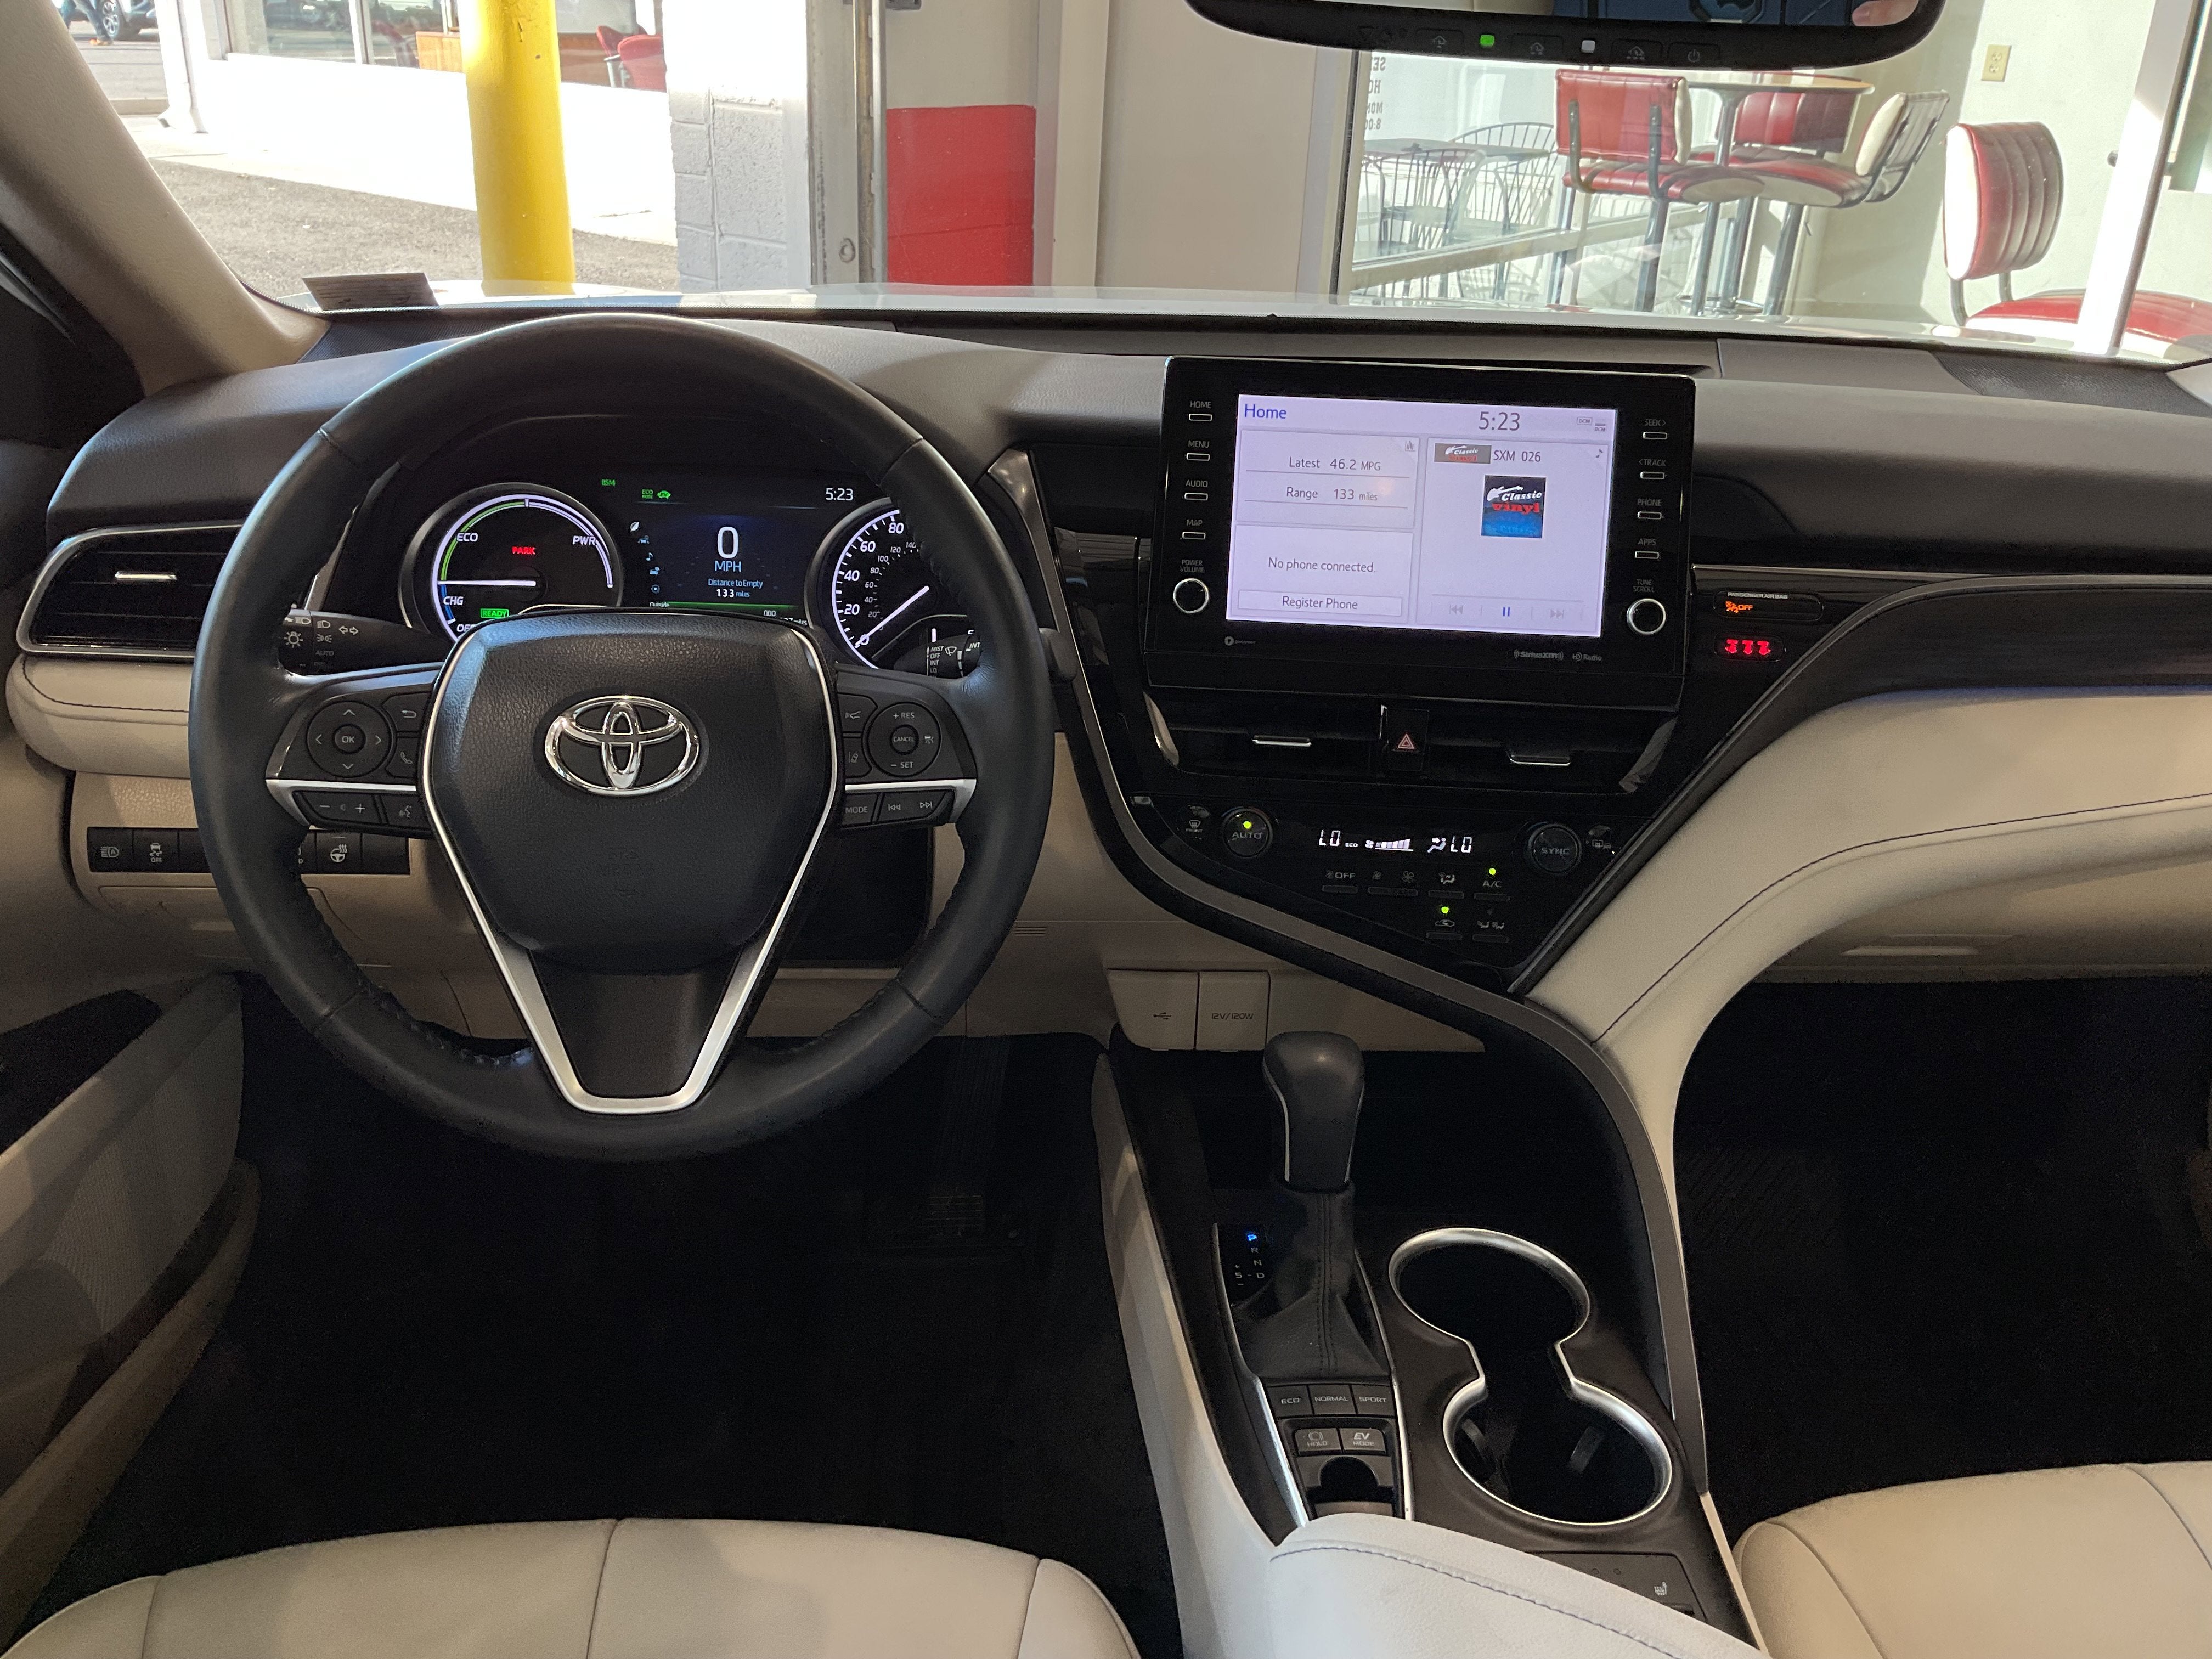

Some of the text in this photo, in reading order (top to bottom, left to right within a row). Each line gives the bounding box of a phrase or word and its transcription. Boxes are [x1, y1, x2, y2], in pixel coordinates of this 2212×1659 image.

[1244, 404, 1287, 419] Home
[1479, 411, 1520, 431] 5:23
[1493, 450, 1541, 462] SXM 026
[1289, 456, 1381, 471] Latest 46.2 MPG
[825, 488, 854, 502] 5:23
[1286, 487, 1378, 501] Range 133 miles
[1502, 490, 1542, 501] Classic
[1492, 501, 1540, 515] vinyl
[1637, 498, 1662, 506] PHONE
[888, 522, 904, 534] 80
[456, 532, 478, 542] ECO
[572, 535, 596, 545] PWR
[717, 526, 738, 558] 0
[860, 541, 876, 552] 60
[714, 560, 741, 572] MPH
[1268, 557, 1376, 572] No phone connected.
[844, 570, 860, 582] 40
[708, 578, 735, 586] Distance
[743, 579, 763, 589] Empty
[716, 589, 734, 597] 133
[443, 596, 464, 606] CHG
[1282, 596, 1358, 609] Register Phone
[844, 603, 860, 615] 20
[1354, 1432, 1370, 1440] EV
